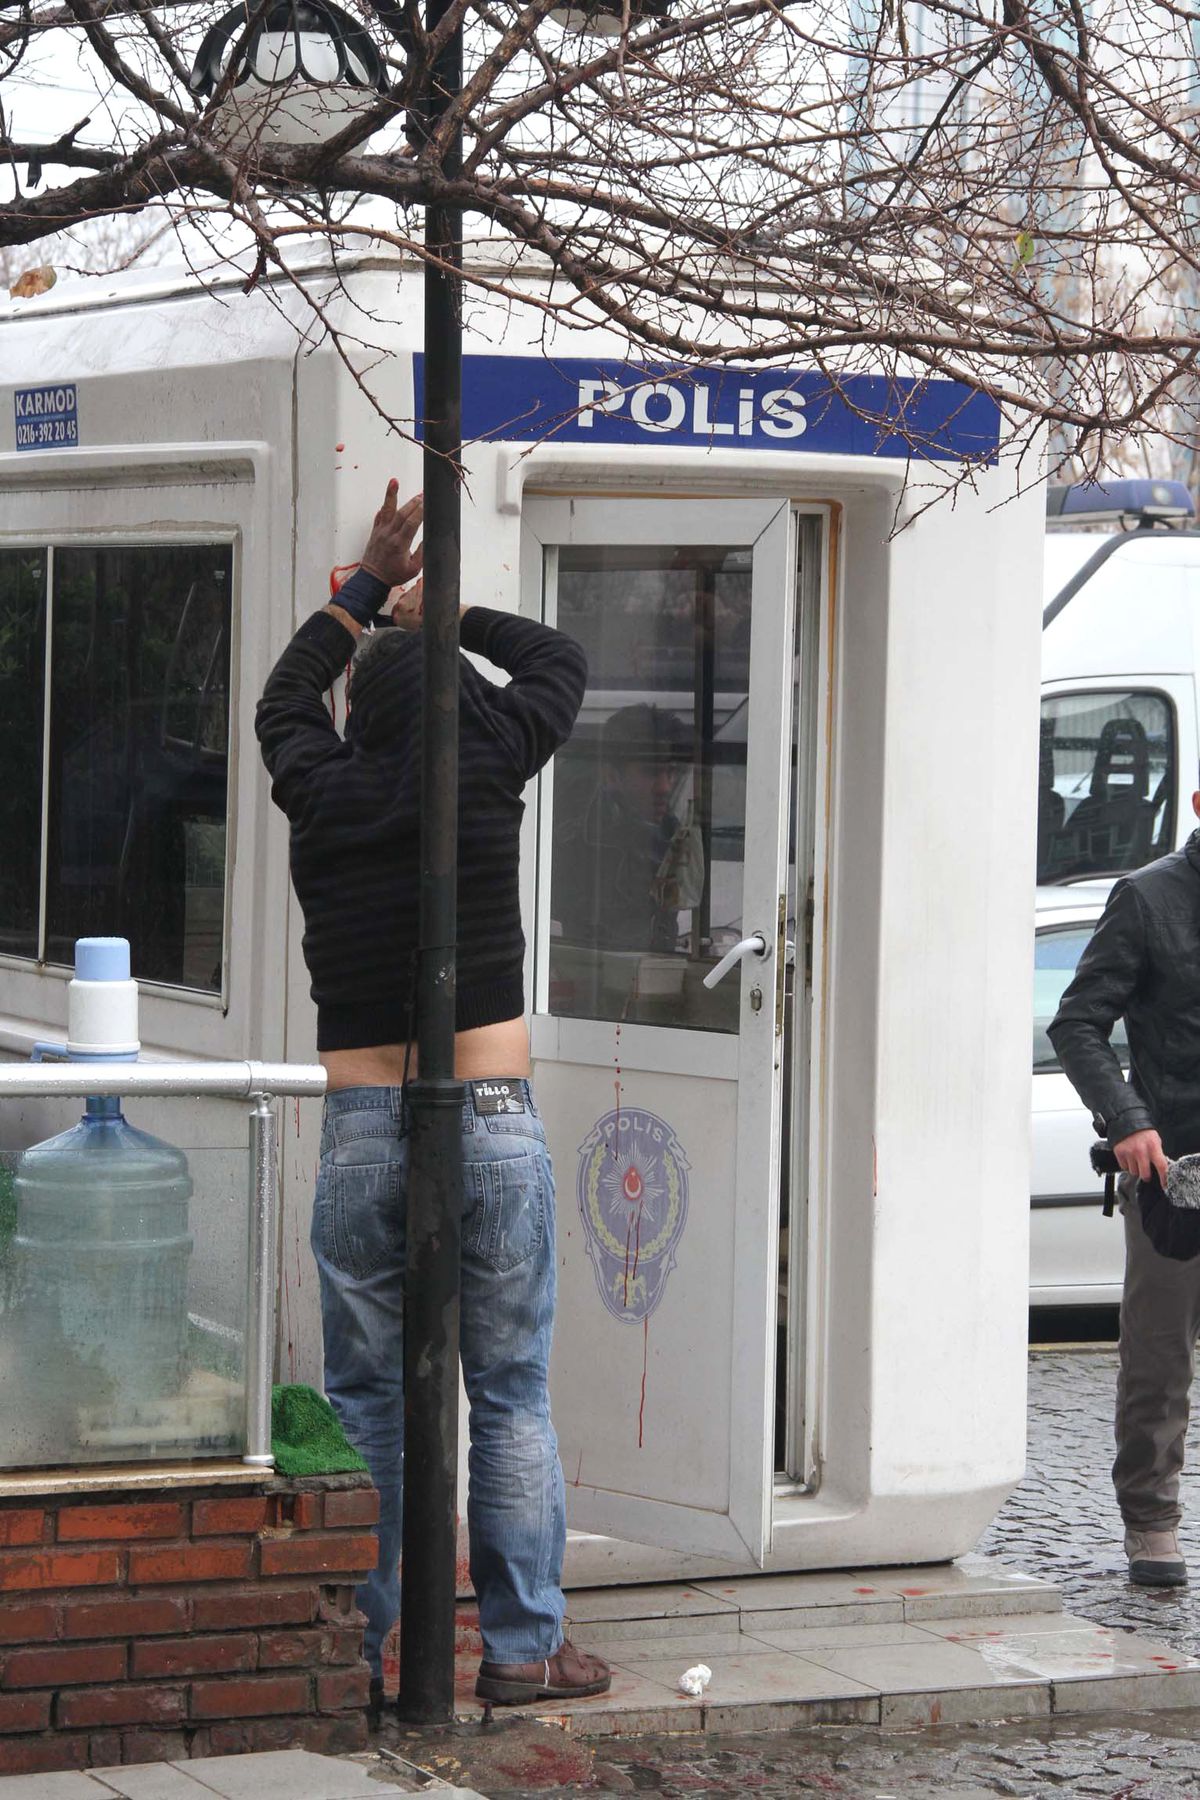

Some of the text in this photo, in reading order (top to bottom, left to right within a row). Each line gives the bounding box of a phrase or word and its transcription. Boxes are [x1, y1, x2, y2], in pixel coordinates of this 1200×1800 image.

[16, 389, 75, 416] KARMOD
[55, 421, 65, 440] 20
[66, 420, 76, 439] 45
